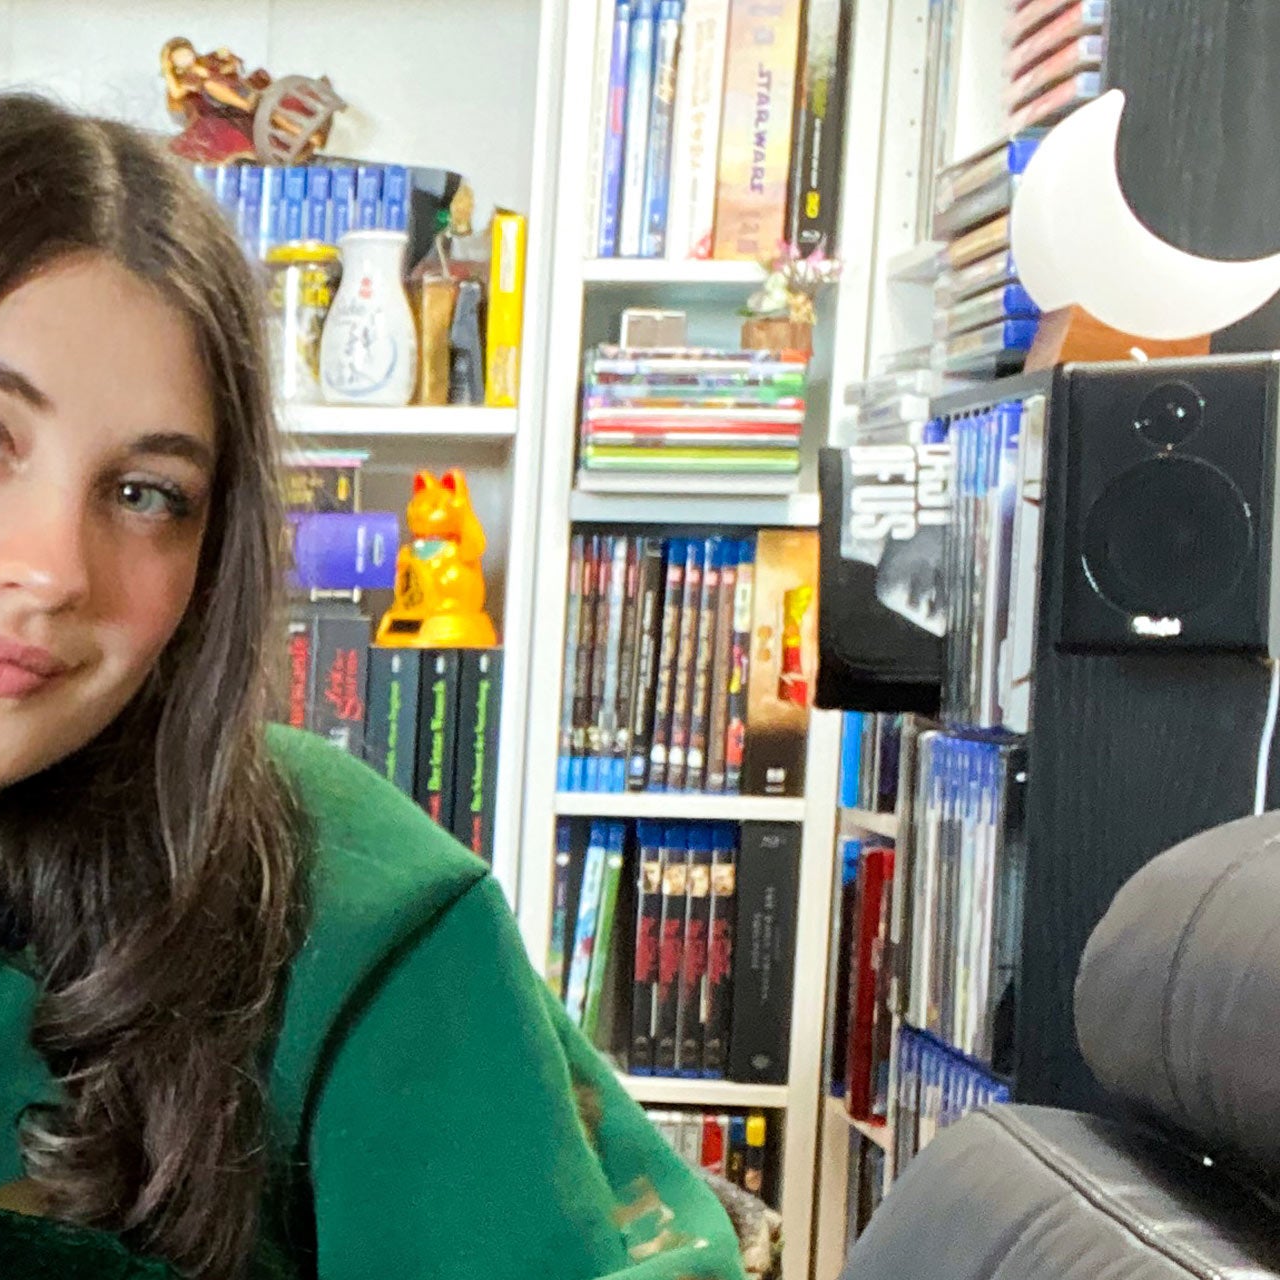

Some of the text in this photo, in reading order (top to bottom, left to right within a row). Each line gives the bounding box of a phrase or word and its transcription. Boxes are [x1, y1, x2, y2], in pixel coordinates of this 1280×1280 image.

[750, 62, 773, 195] STAR WARS
[849, 485, 917, 540] US
